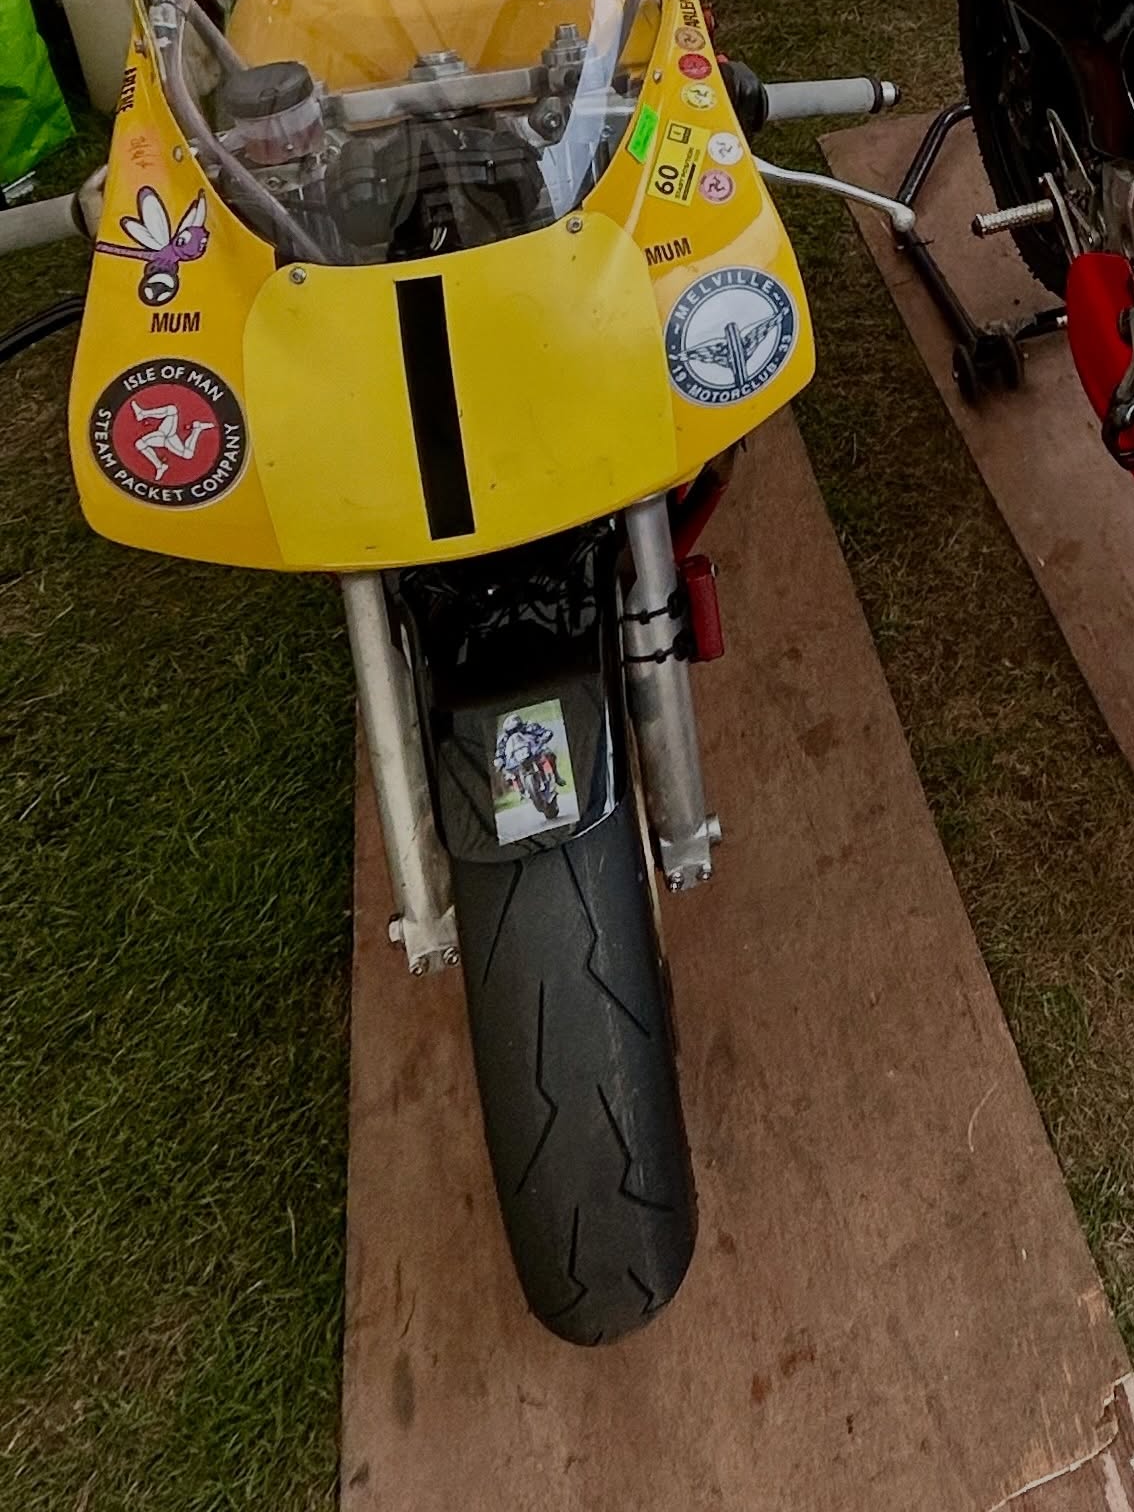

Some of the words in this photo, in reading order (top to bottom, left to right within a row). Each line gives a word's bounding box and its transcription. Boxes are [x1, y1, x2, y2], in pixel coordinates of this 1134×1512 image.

[655, 164, 679, 195] 60
[644, 237, 692, 266] MUM
[674, 271, 775, 320] MELVILLE
[151, 312, 200, 333] MUM
[123, 368, 156, 391] ISLE
[161, 366, 185, 380] OF
[187, 370, 224, 401] MAN
[688, 364, 777, 402] MOTORCLUB
[94, 408, 118, 468] STEAM
[114, 469, 185, 502] PACKET
[191, 423, 240, 498] COMPANY
